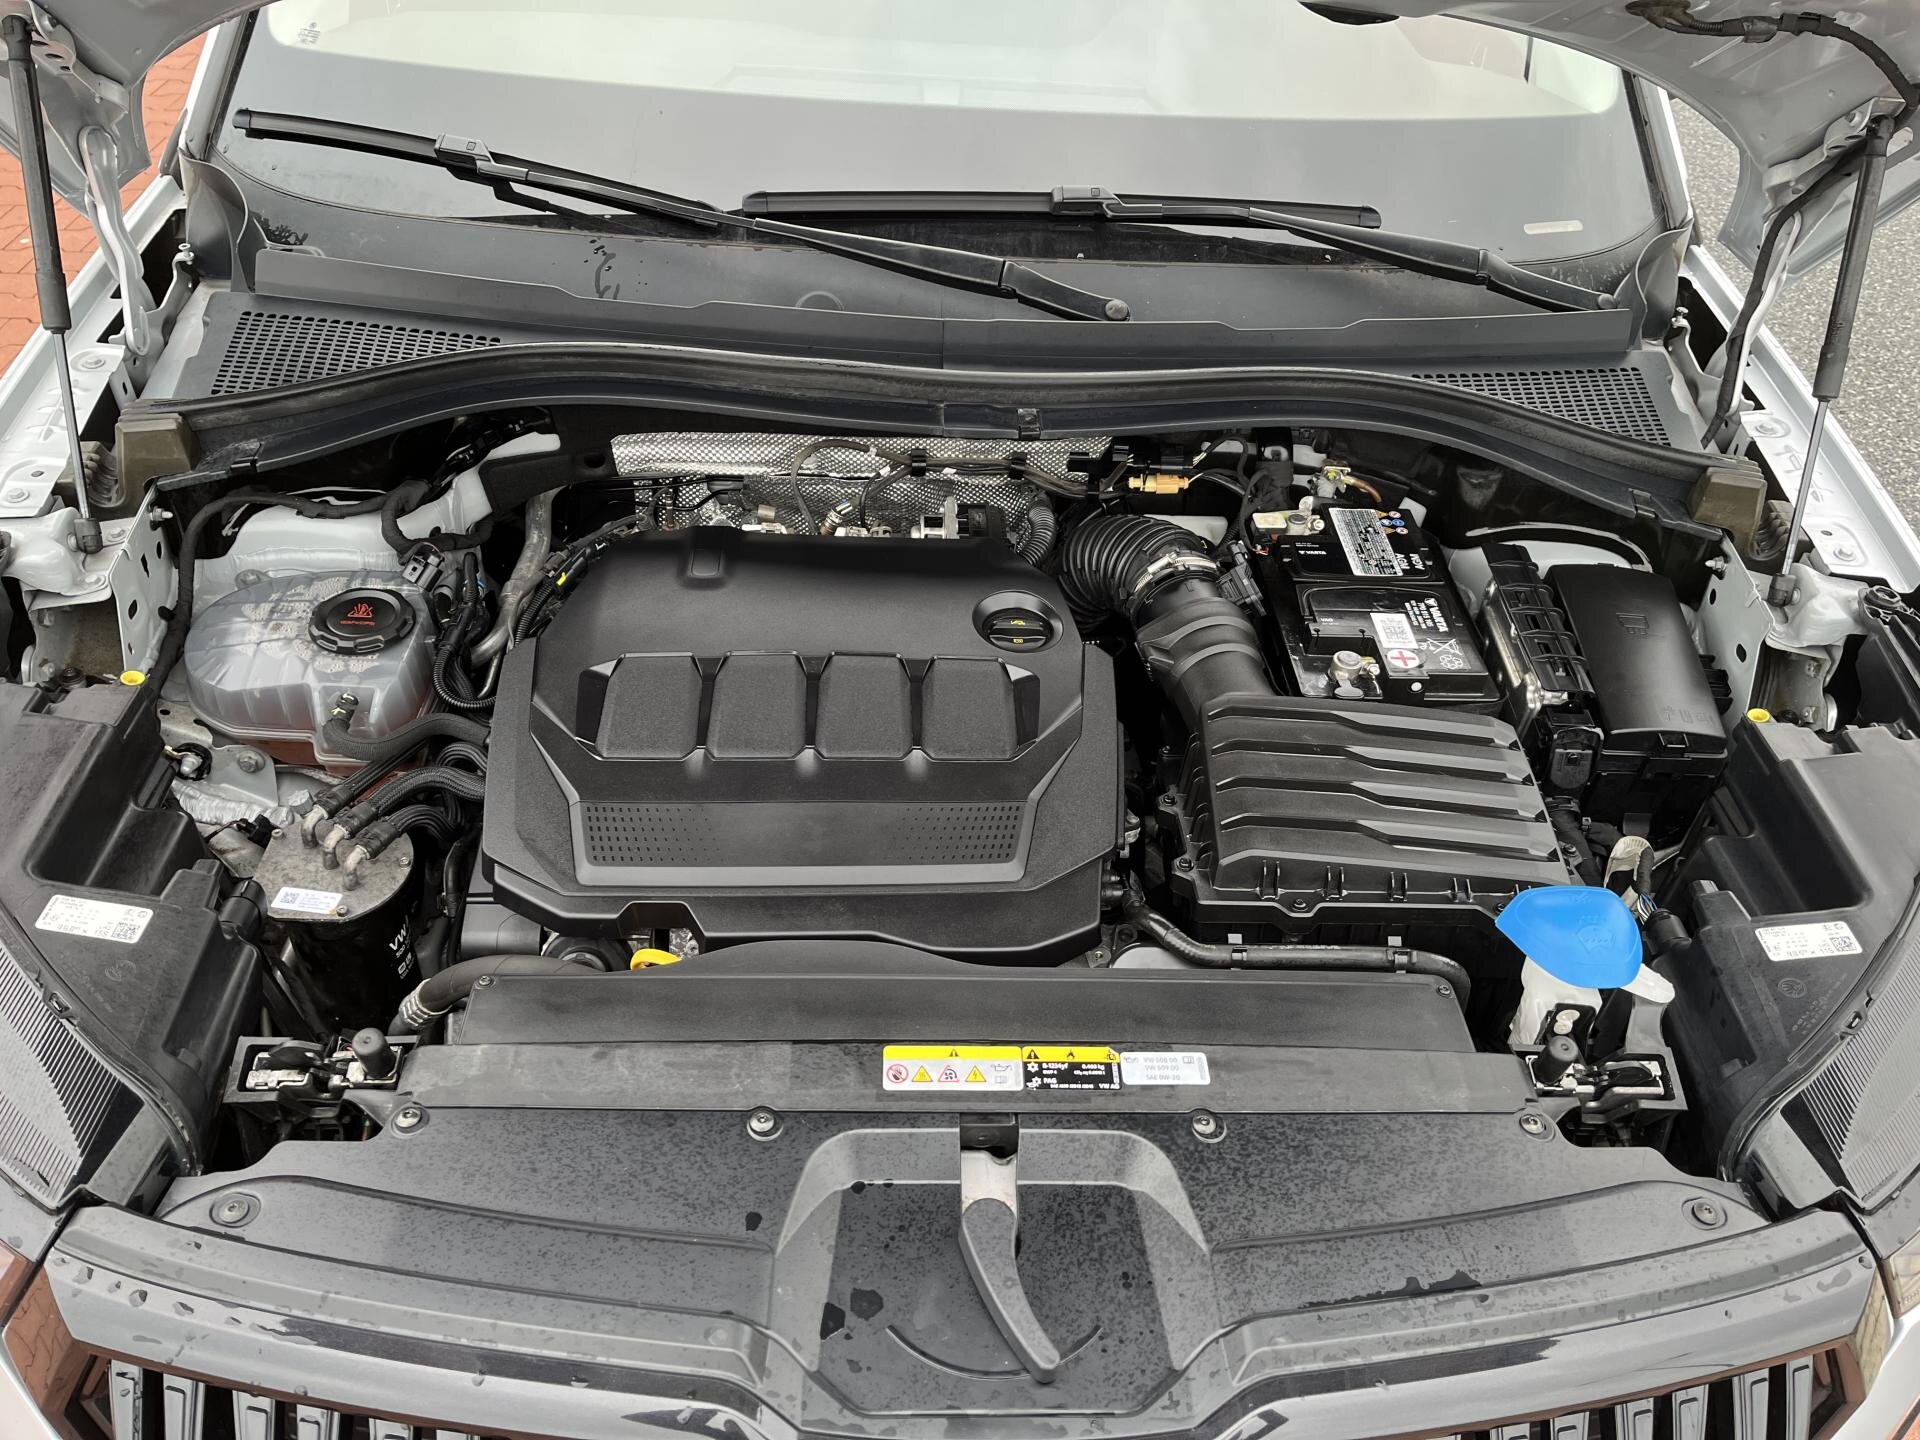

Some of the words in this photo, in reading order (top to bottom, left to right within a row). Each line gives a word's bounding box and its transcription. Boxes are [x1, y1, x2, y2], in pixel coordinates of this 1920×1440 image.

[1395, 552, 1410, 569] AGM
[1410, 553, 1425, 570] AGM
[1430, 606, 1449, 632] VARTA
